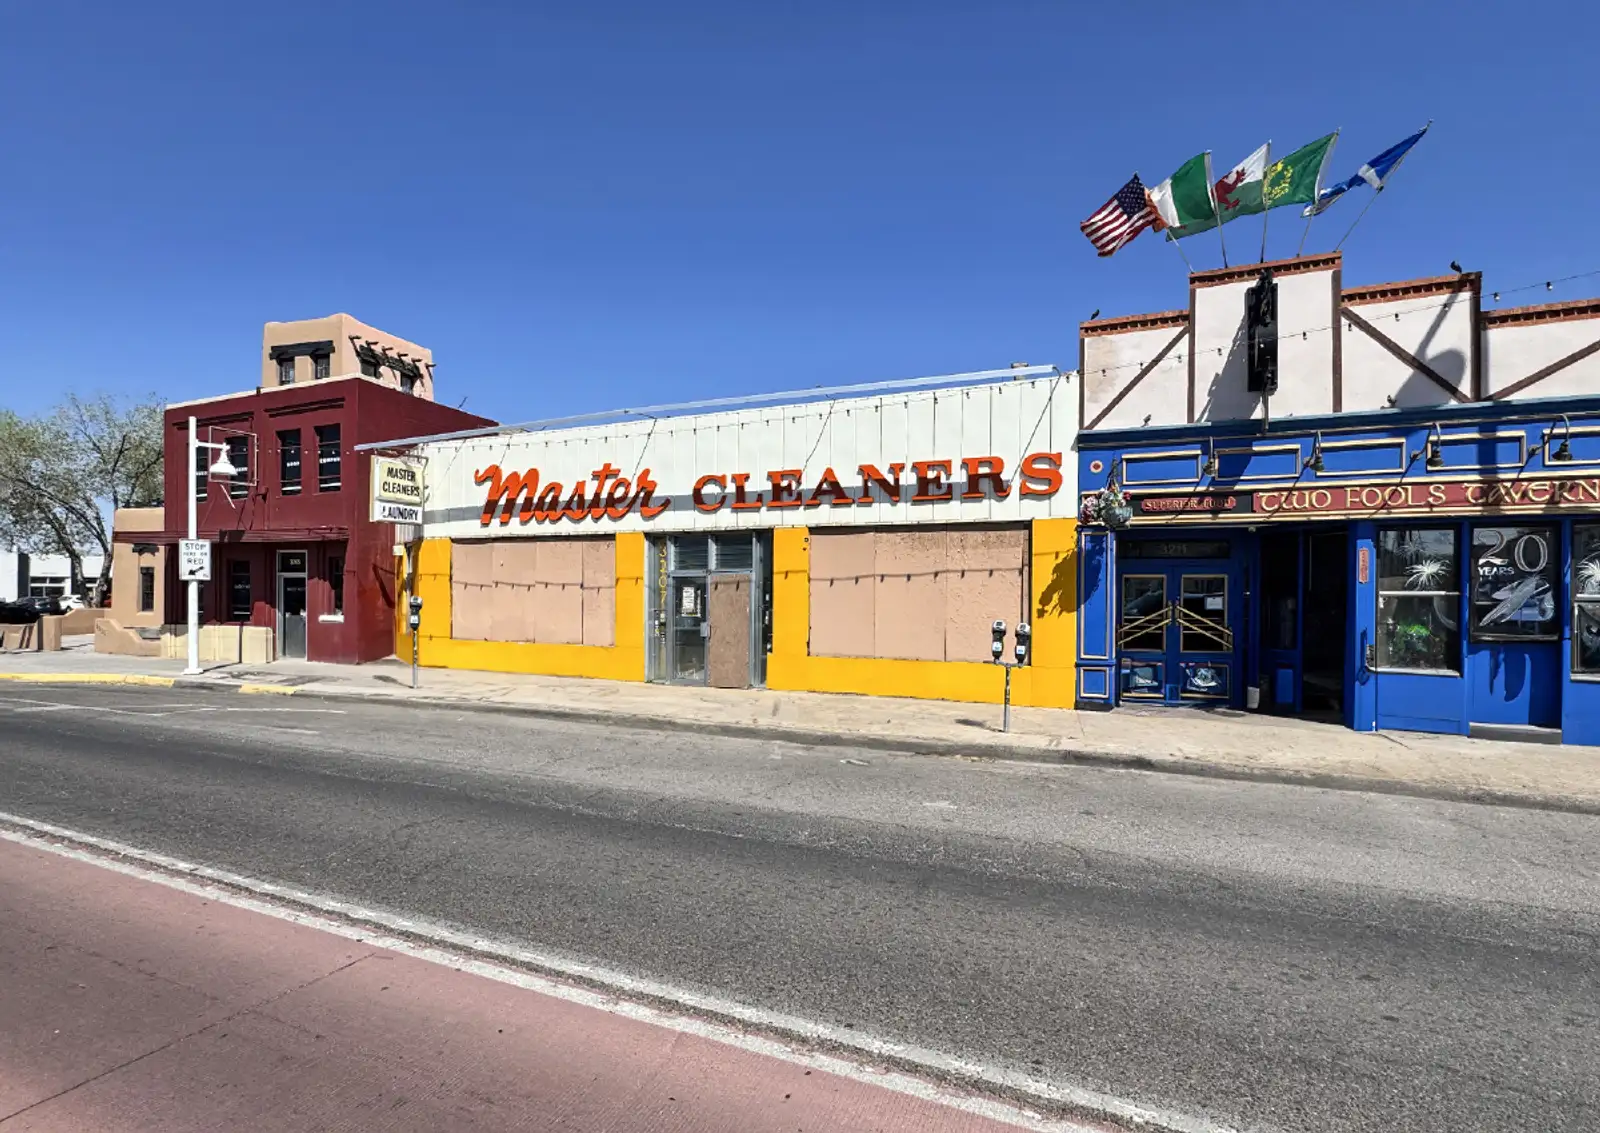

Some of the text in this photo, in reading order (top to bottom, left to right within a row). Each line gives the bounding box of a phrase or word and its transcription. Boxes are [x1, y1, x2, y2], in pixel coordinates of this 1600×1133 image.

[387, 467, 416, 482] MASTER
[382, 481, 420, 497] CLEANERS
[473, 452, 1063, 526] Master CLEANERS
[1258, 479, 1600, 511] TWO FOOLS TAVERN
[382, 505, 419, 521] LAUNDRY
[1477, 530, 1549, 572] 20
[1477, 566, 1516, 577] YEARS
